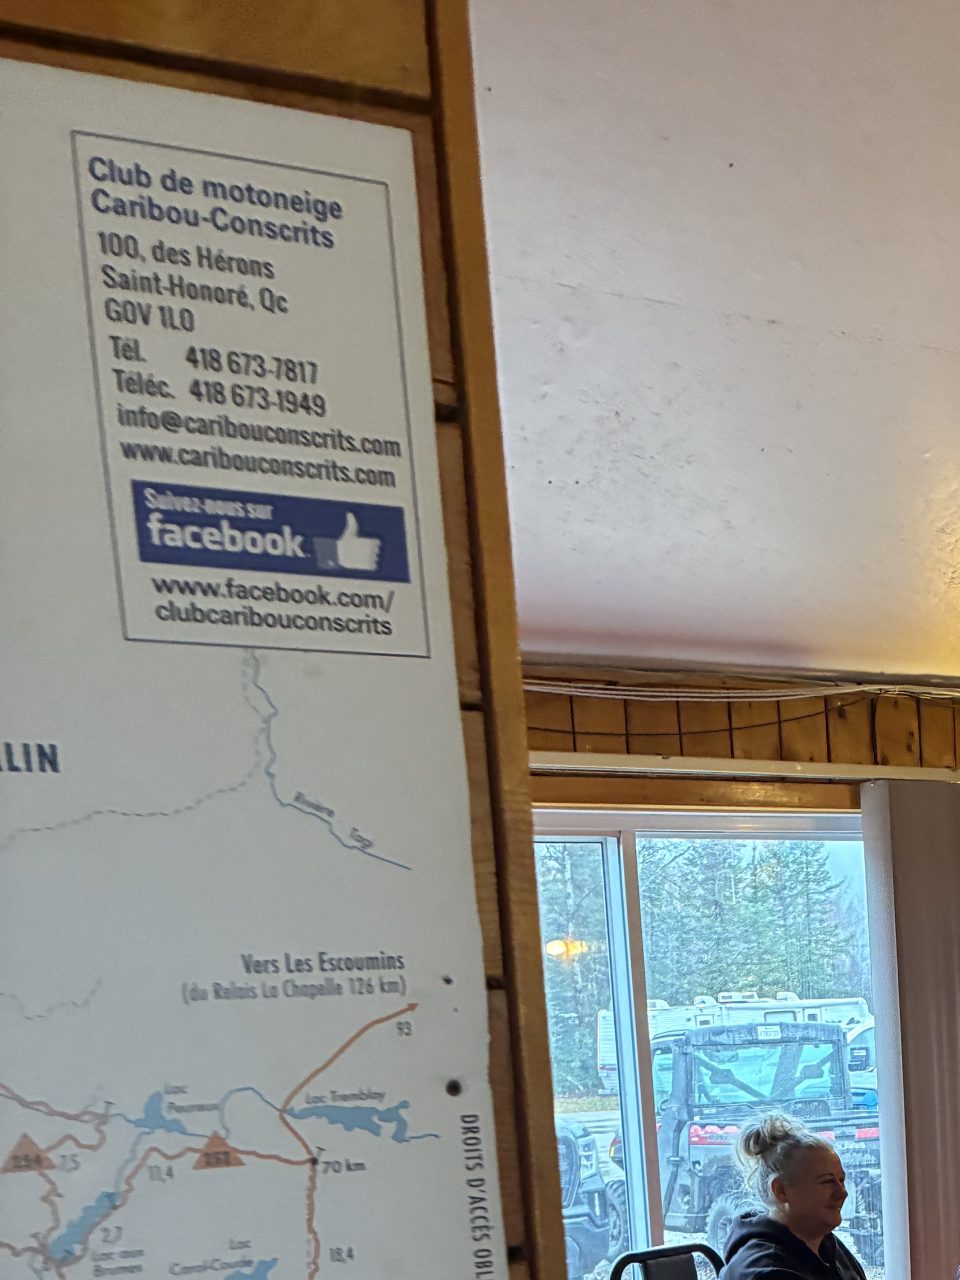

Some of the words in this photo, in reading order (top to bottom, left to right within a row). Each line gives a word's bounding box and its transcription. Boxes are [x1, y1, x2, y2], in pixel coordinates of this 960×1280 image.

[88, 156, 152, 188] Club
[161, 168, 194, 195] de
[203, 179, 343, 223] motoneige
[91, 188, 335, 249] Caribou-Conscrits
[98, 232, 146, 262] 100,
[152, 240, 191, 266] des
[197, 246, 275, 280] Hérons
[101, 264, 255, 311] Saint-Honoré,
[259, 287, 289, 314] Qc
[109, 335, 147, 364] Tél.
[185, 345, 221, 373] 418
[227, 351, 318, 386] 673-7817
[112, 368, 177, 401] Téléc.
[189, 378, 226, 407] 418
[231, 385, 326, 418] 673-1949
[117, 403, 401, 458] info@caribouconscrits.com
[120, 439, 396, 487] www.caribouconscrits.com
[146, 511, 305, 558] facebook
[151, 576, 395, 614] www.facebook.com/
[155, 601, 392, 636] clubcaribouconscrits
[0, 742, 60, 773] LIN
[241, 953, 280, 974] Vers
[285, 953, 312, 973] Les
[318, 951, 405, 972] Escoumins
[348, 978, 374, 995] 126
[379, 976, 406, 996] km)
[345, 1159, 366, 1171] km
[460, 1114, 484, 1172] DROITS
[466, 1178, 494, 1242] D'ACCÈS
